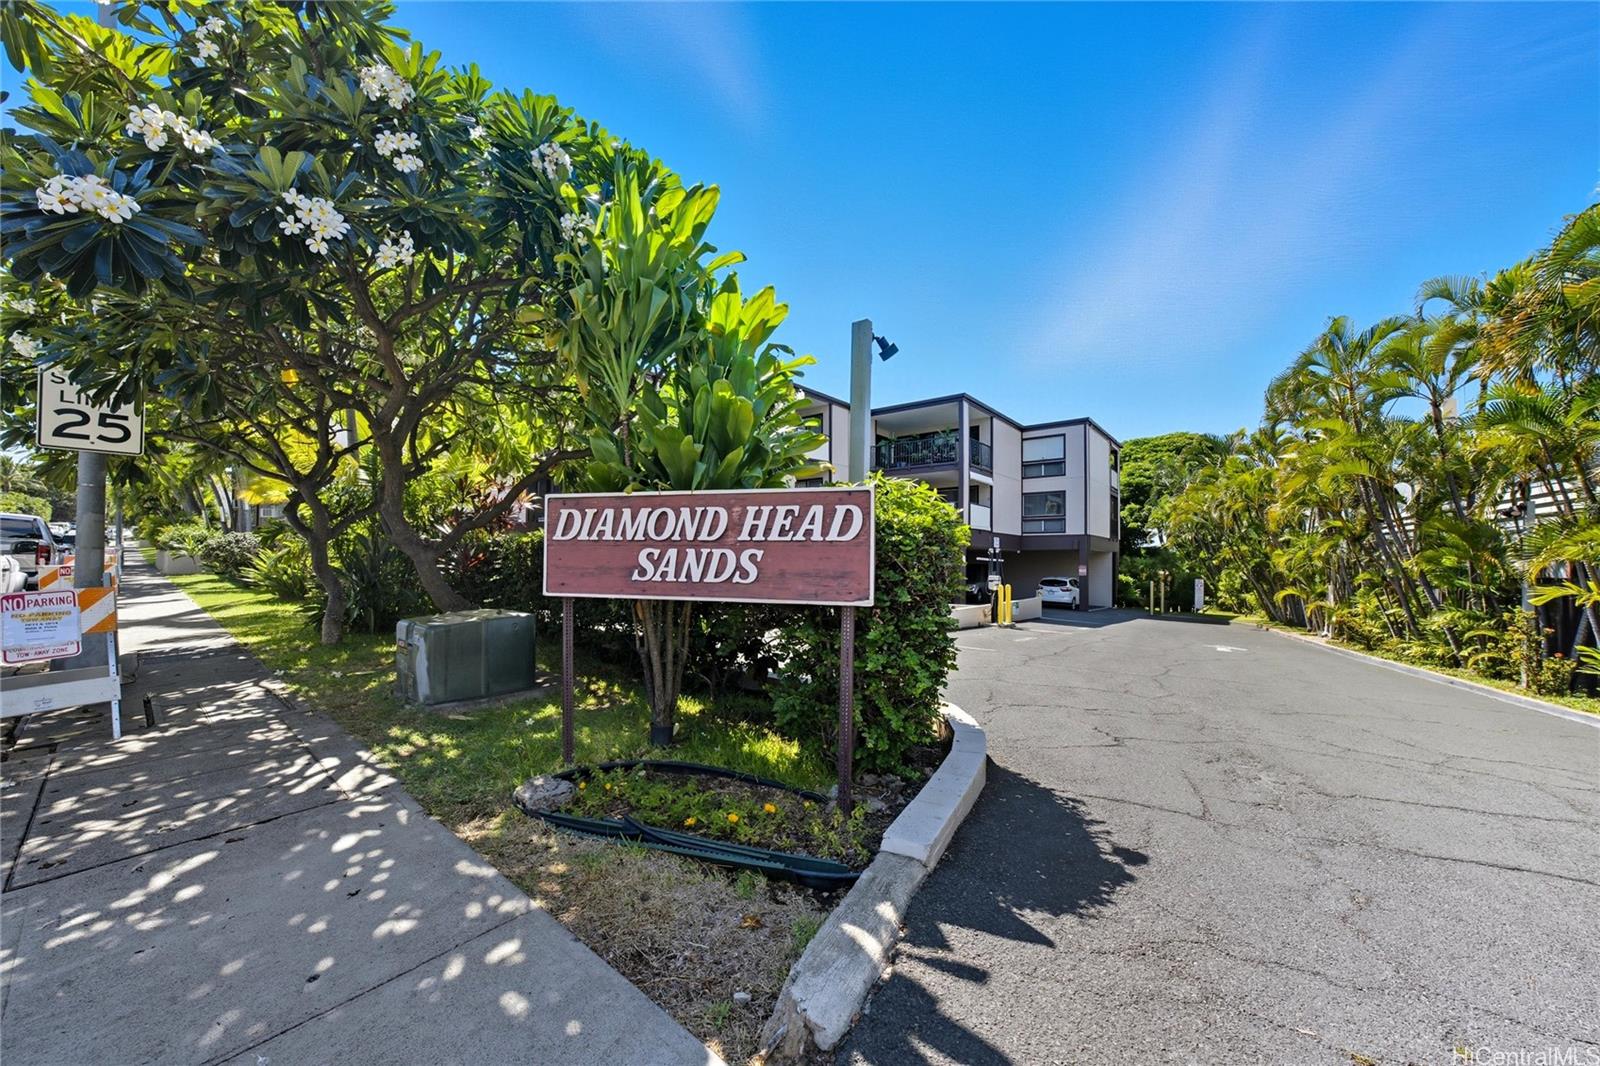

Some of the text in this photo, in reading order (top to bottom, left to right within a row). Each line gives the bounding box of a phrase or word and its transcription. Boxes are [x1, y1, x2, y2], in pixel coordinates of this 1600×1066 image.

[52, 408, 132, 444] 25
[552, 504, 864, 542] DIAMOND HEAD
[60, 567, 71, 576] NO
[631, 547, 764, 585] SANDS
[2, 596, 73, 611] NO PARKING
[52, 646, 69, 654] ZONE
